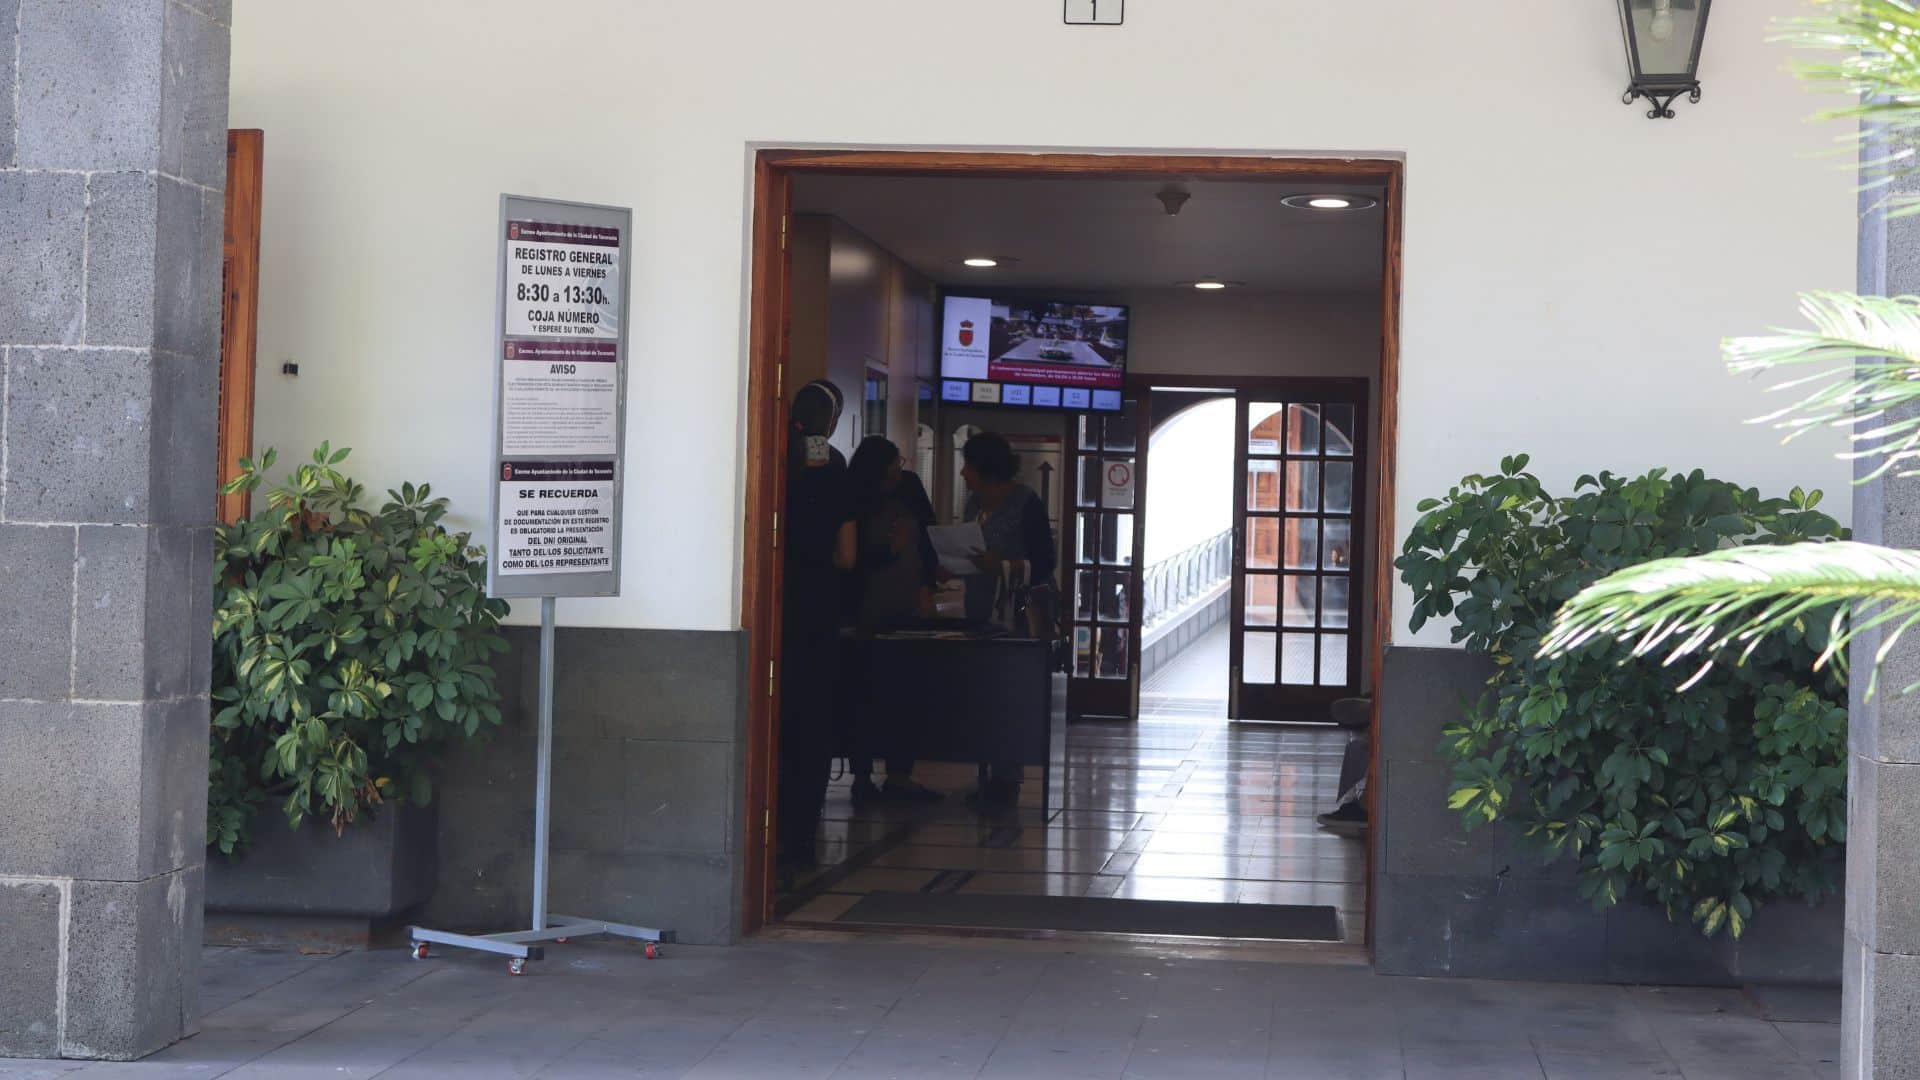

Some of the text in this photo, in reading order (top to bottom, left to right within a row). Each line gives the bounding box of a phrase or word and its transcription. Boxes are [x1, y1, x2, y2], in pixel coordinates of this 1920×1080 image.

[515, 247, 612, 264] REGISTRO GENERAL
[522, 265, 606, 278] DE LUNES A VIERNES
[517, 283, 549, 302] 8:30
[553, 292, 560, 302] a
[528, 308, 599, 324] COJA NÚMERO
[550, 364, 576, 374] AVISO
[519, 489, 598, 498] SE RECUERDA
[563, 547, 604, 555] SOLICITANTE
[556, 558, 609, 566] REPRESENTANTE
